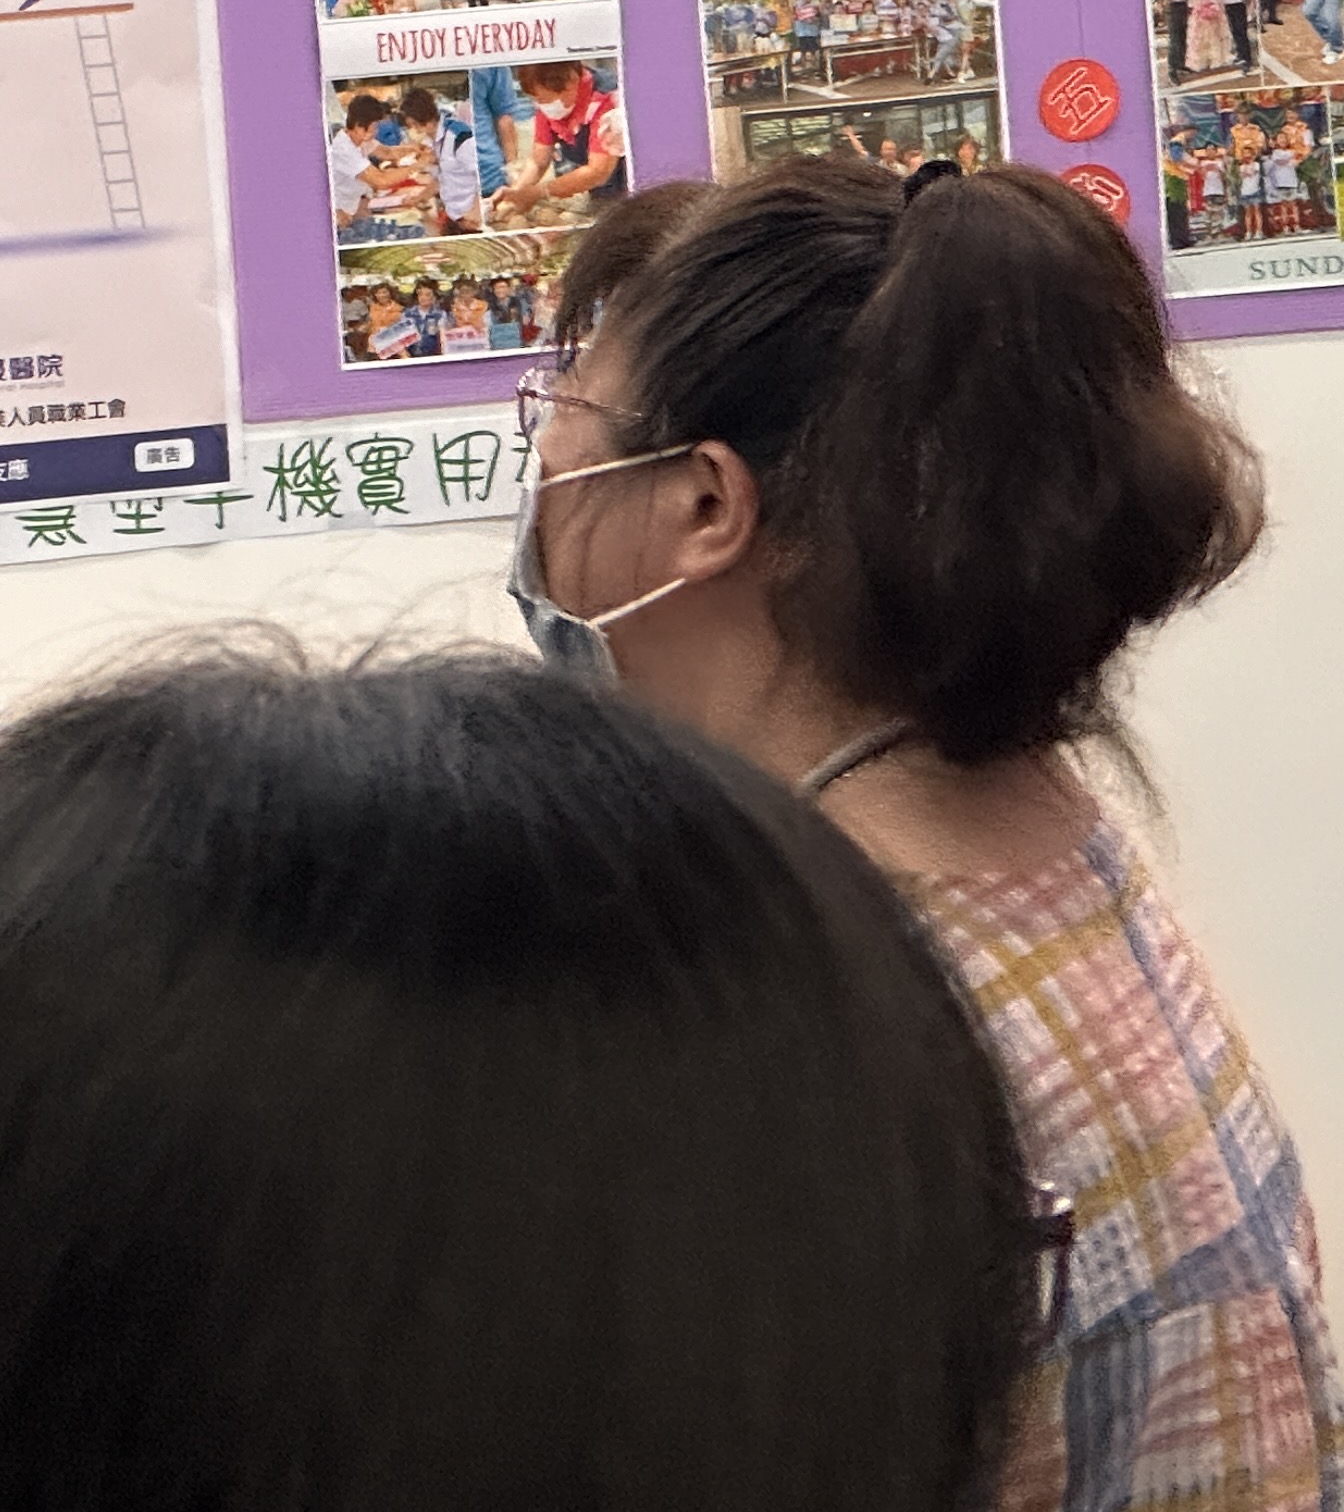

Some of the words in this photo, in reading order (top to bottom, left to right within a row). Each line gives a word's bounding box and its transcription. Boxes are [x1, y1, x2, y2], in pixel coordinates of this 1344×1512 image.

[376, 27, 448, 64] ENJOY
[454, 18, 558, 58] EVERYDAY
[144, 445, 182, 465] 廣告
